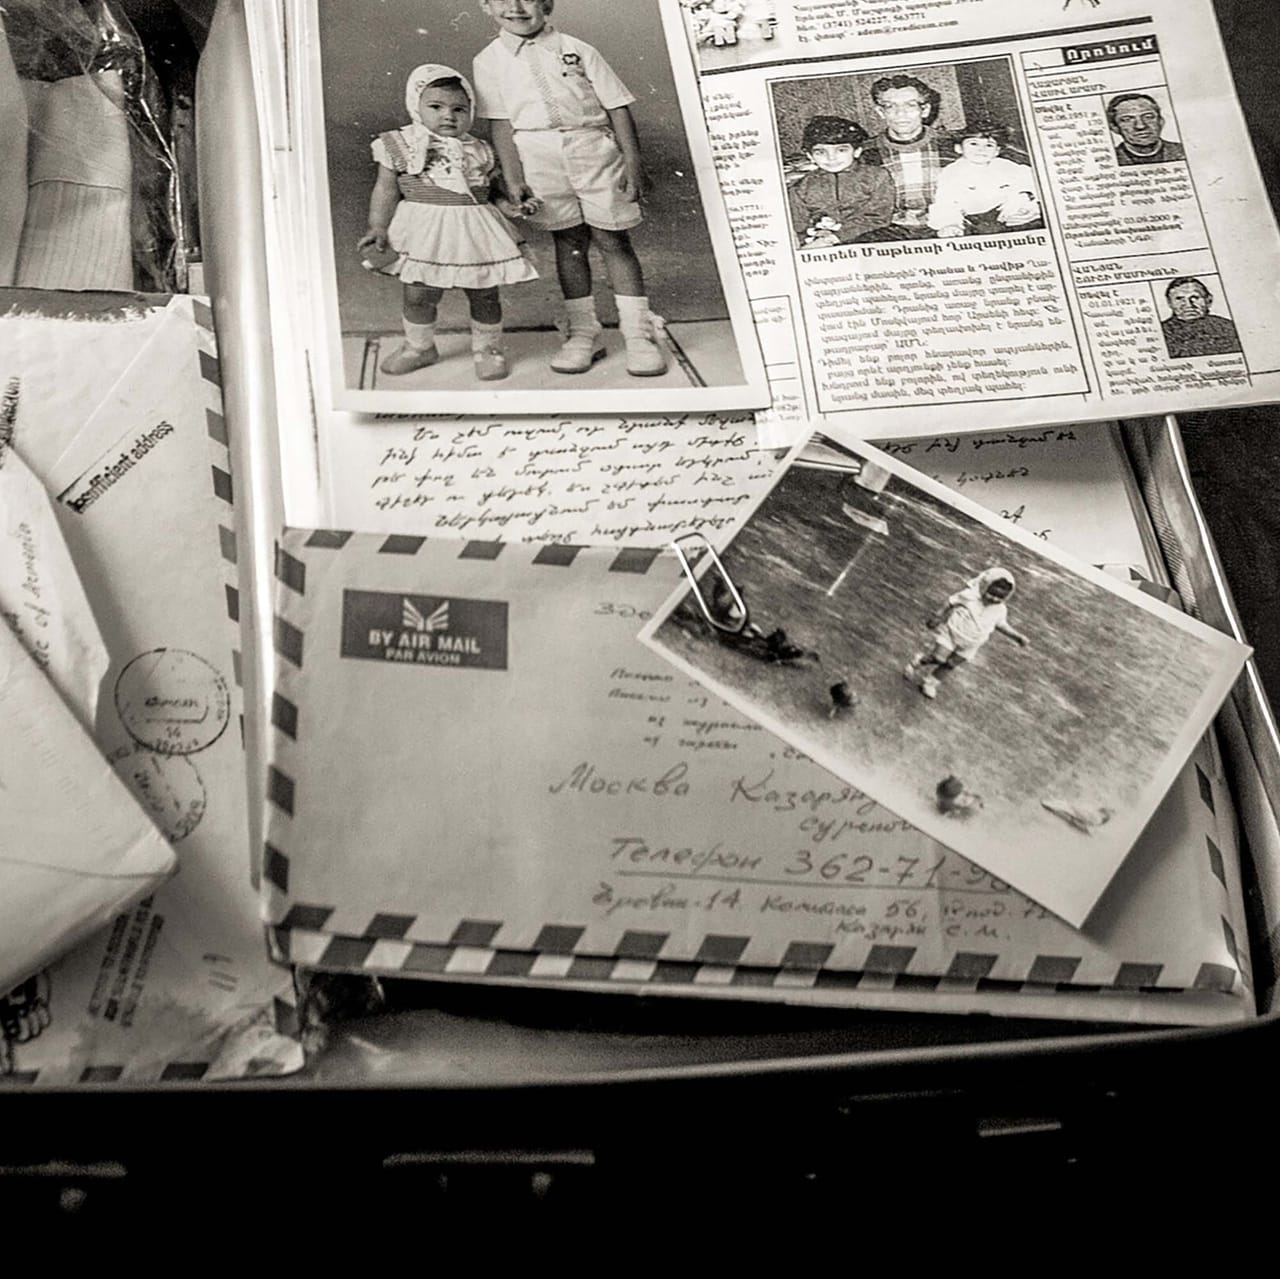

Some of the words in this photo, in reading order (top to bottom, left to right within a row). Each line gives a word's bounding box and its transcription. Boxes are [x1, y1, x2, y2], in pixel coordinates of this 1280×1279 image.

[1066, 38, 1154, 62] Որոնում
[801, 249, 856, 263] Սուրեն
[861, 243, 942, 259] Մաթևոսի
[946, 235, 1046, 251] Ղազարյանը
[919, 267, 964, 278] Դիանա
[967, 264, 976, 272] և
[978, 261, 1024, 271] Դավիթ
[130, 420, 175, 460] address
[369, 629, 394, 646] BY
[398, 632, 431, 649] AIR
[438, 635, 481, 654] MAIL
[385, 647, 415, 661] PAR
[417, 650, 461, 665] AVION
[549, 761, 689, 797] Москва
[612, 837, 763, 872] Телефон
